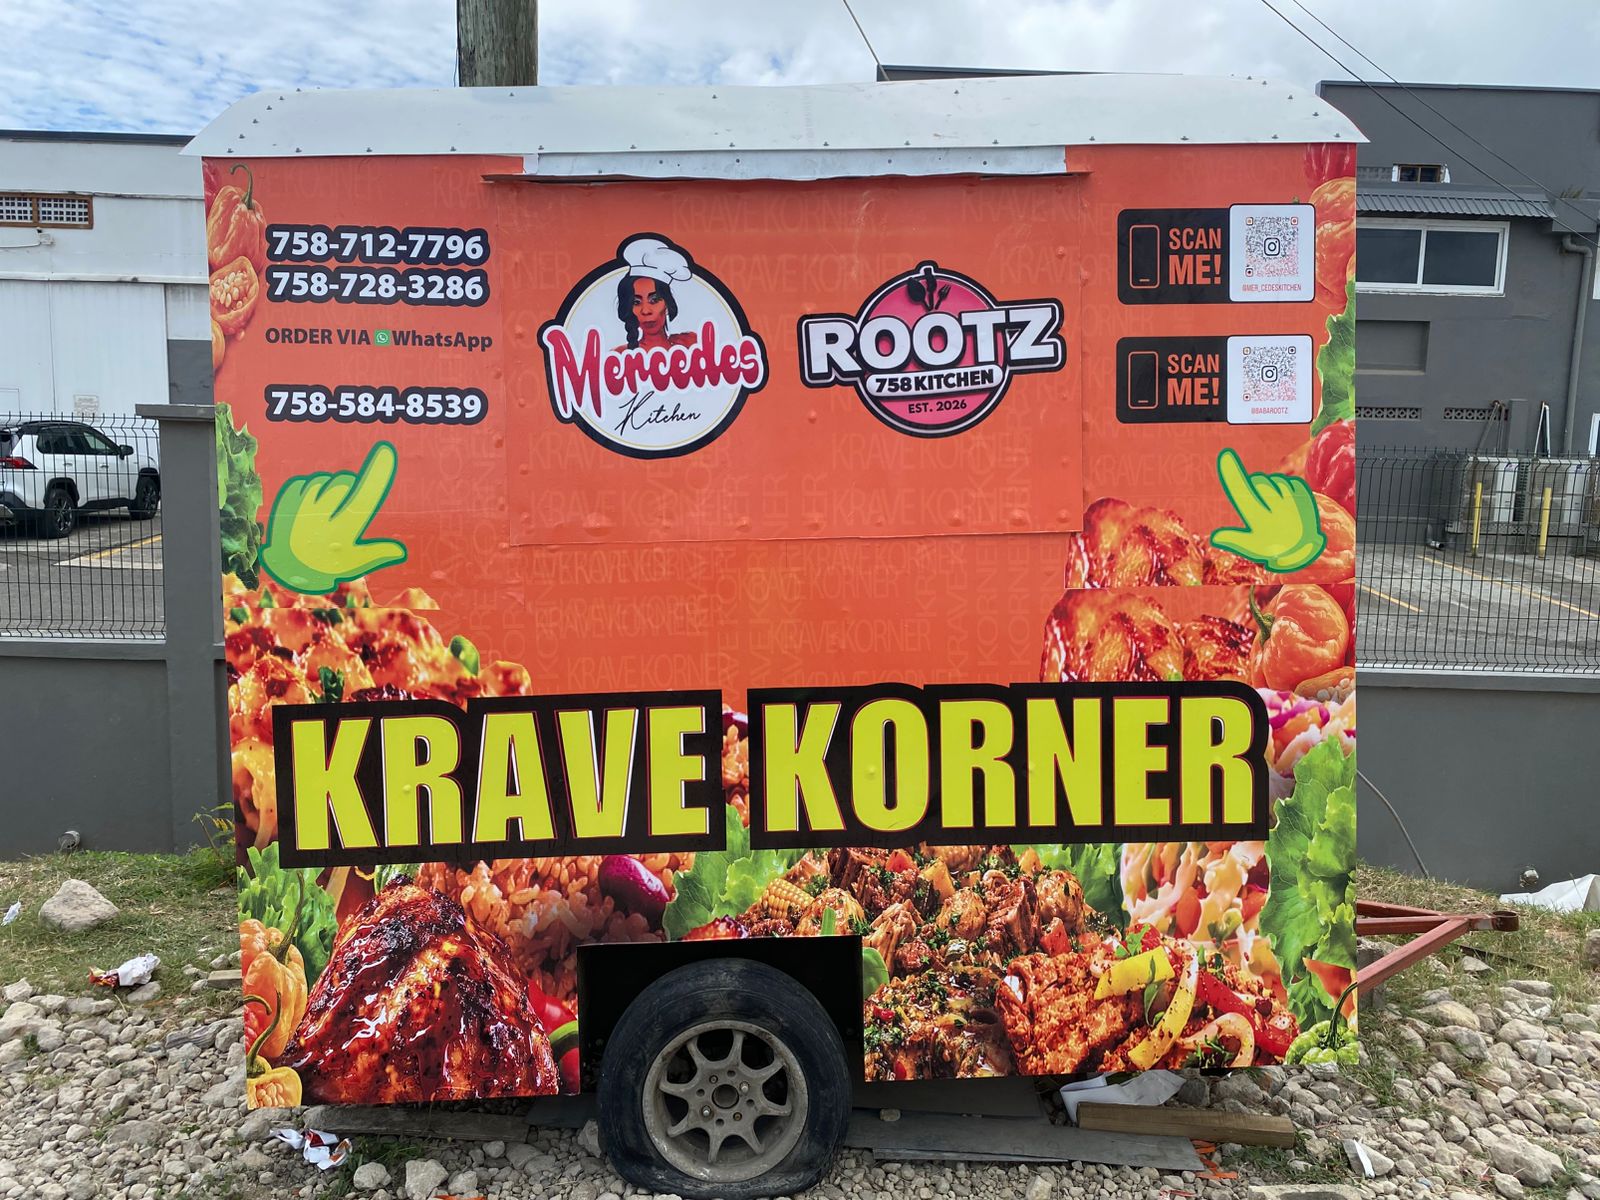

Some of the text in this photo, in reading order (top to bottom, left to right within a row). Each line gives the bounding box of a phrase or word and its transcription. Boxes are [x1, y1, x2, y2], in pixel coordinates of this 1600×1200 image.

[272, 231, 484, 260] 758-712-7796
[1168, 227, 1222, 250] SCAN
[1168, 253, 1222, 285] ME!
[272, 271, 484, 300] 758-728-3286
[265, 327, 493, 352] ORDER VIA WhatsApp
[808, 307, 1055, 374] ROOTZ
[546, 320, 761, 419] Mercedes
[1167, 353, 1220, 375] SCAN
[271, 390, 482, 419] 758-584-8539
[1167, 377, 1220, 406] ME!
[614, 390, 702, 436] Kitchen
[908, 399, 968, 415] EST. 2026
[291, 696, 1255, 850] KRAVE KORNER
